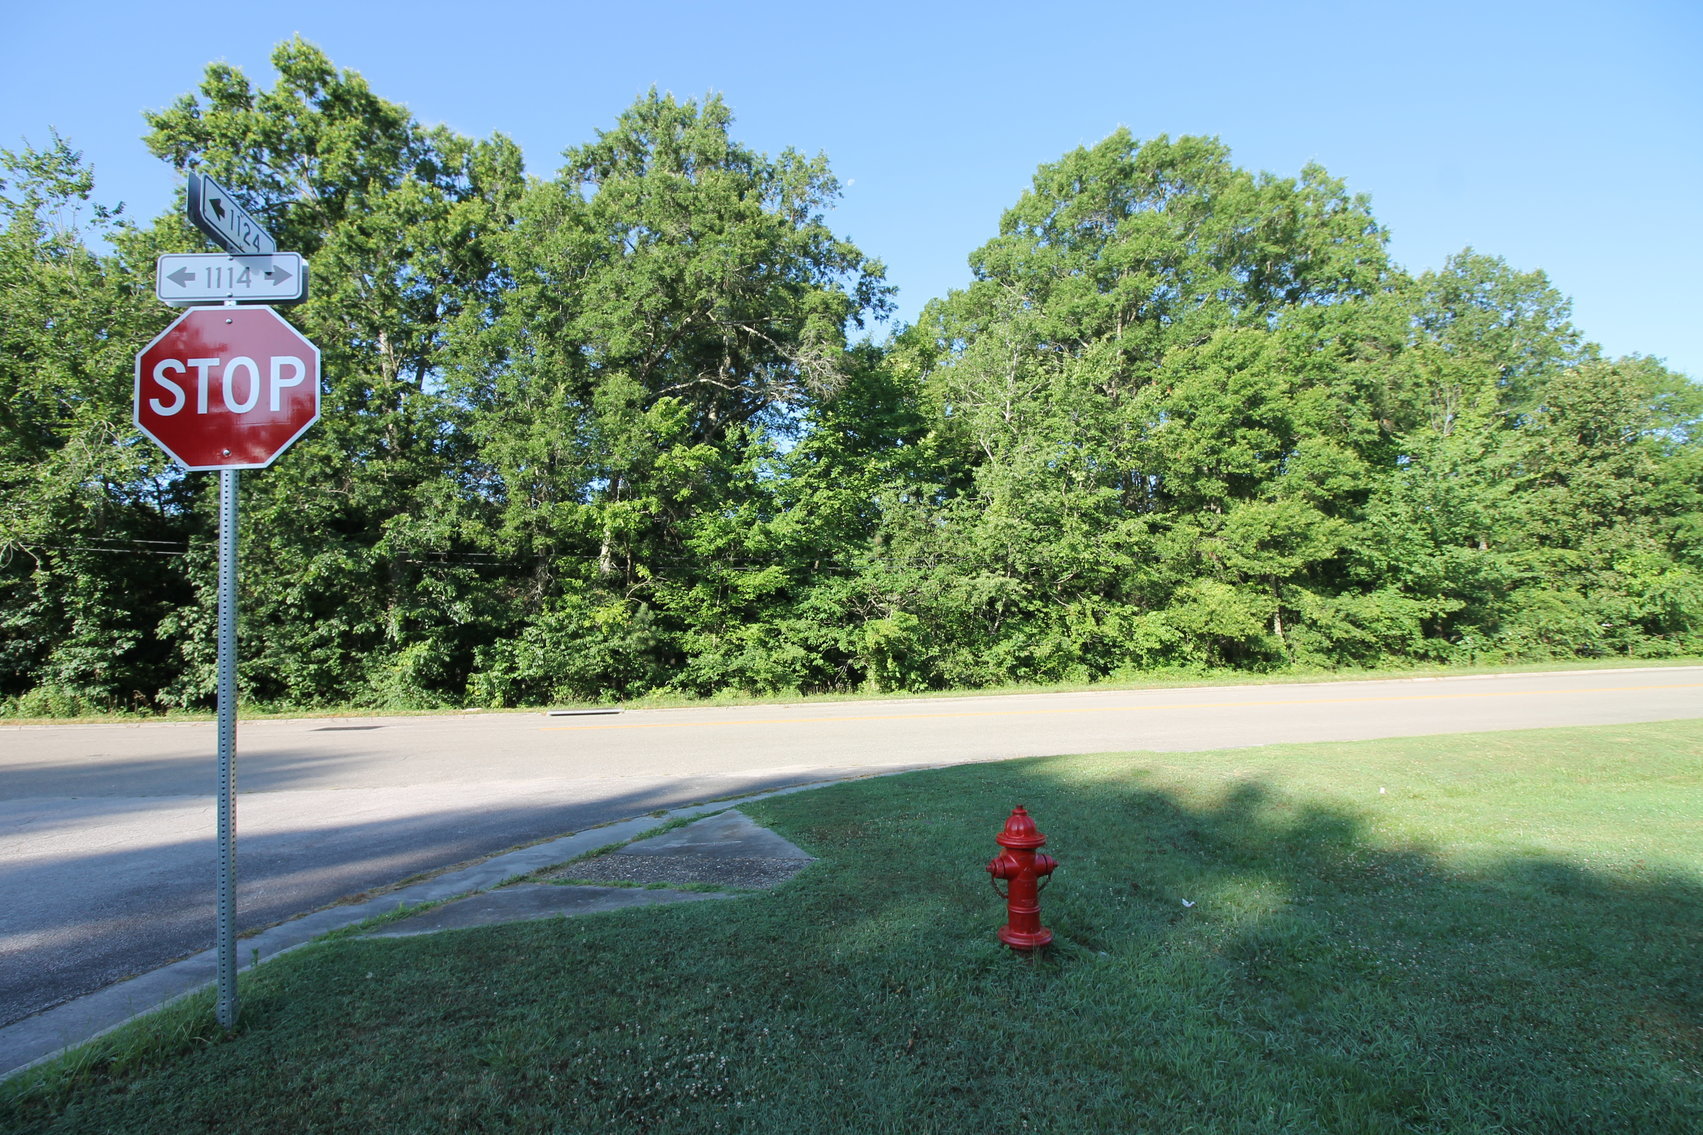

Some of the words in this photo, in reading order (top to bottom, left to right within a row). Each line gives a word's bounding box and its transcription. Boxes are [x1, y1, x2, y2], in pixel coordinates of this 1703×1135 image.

[230, 208, 260, 253] 1124
[205, 266, 252, 289] 1114
[149, 356, 306, 417] STOP
